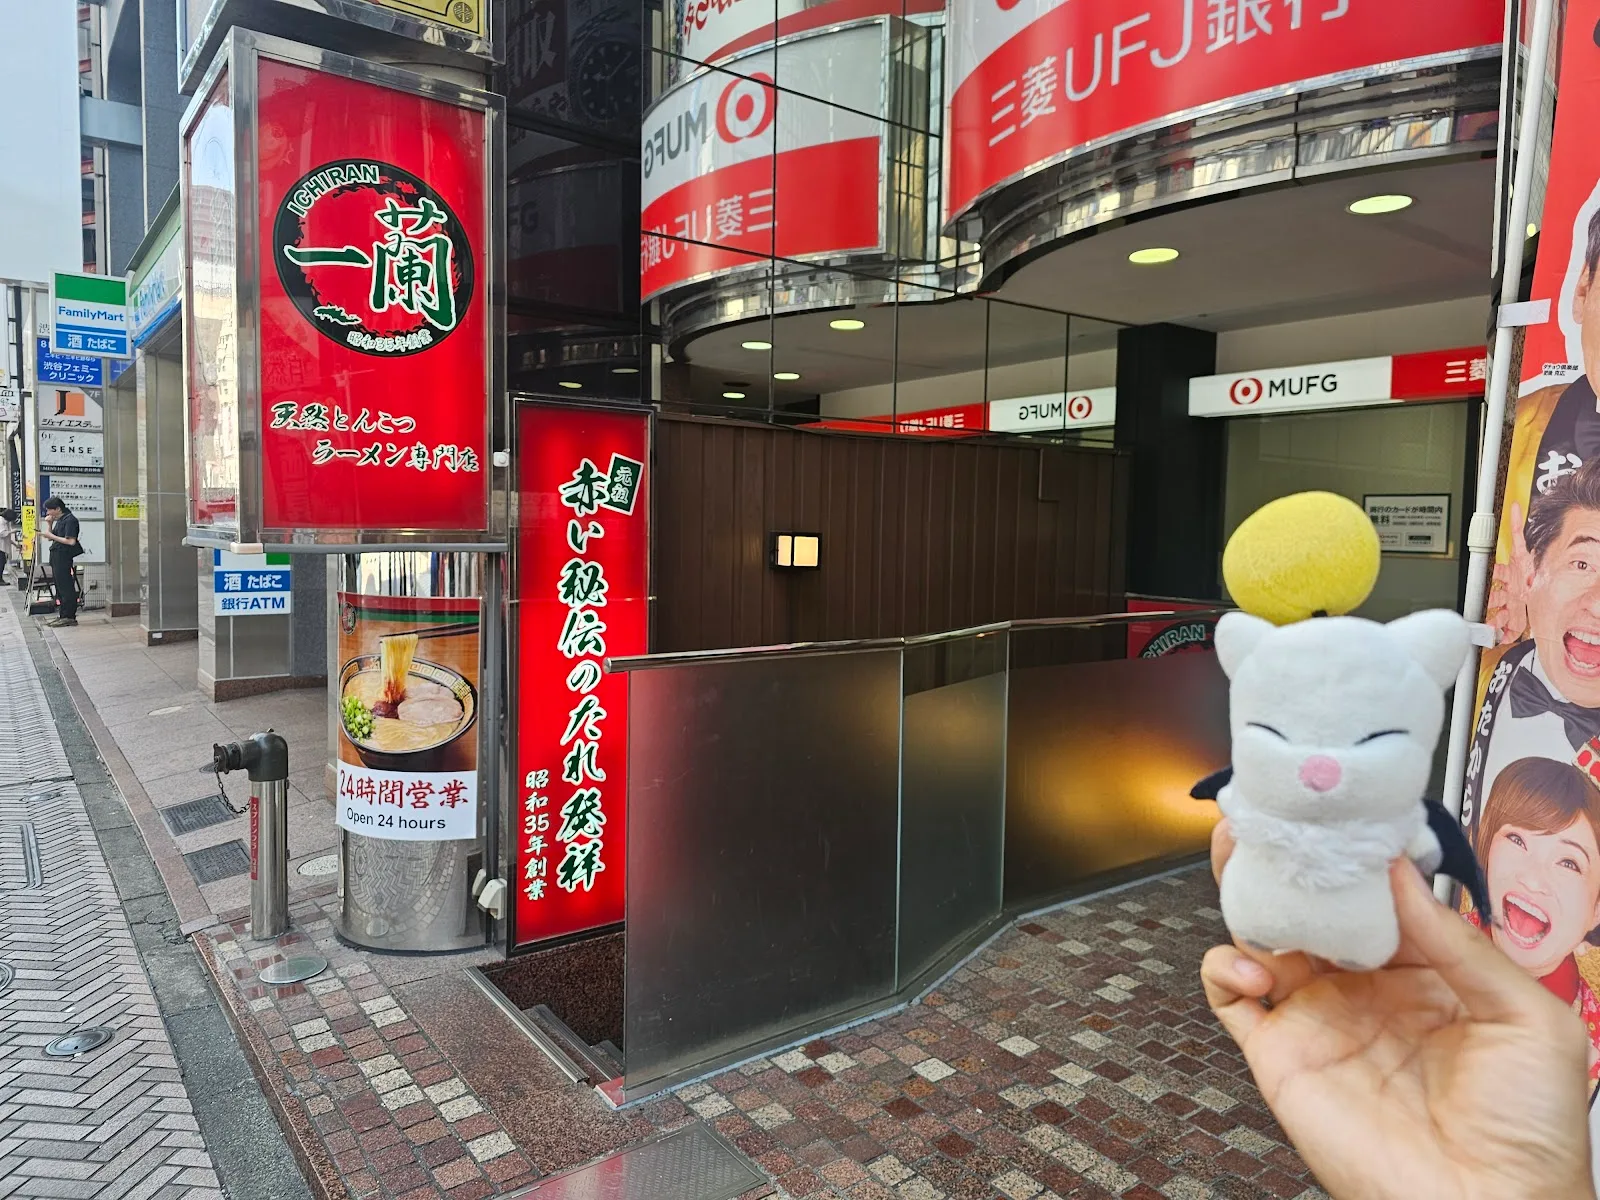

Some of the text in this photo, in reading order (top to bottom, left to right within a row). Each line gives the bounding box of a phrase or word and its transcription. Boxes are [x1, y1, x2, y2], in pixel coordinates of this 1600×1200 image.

[287, 164, 380, 218] ICHIRAN
[284, 197, 456, 331] 一蘭
[58, 306, 124, 321] FamilyMart
[68, 333, 117, 350] 酒 たばこ
[43, 362, 99, 373] 渋谷フェミー
[49, 371, 94, 382] クリニック
[1269, 374, 1338, 398] MUFG
[270, 401, 416, 434] 天然とんこつ
[51, 446, 93, 454] SENSE
[312, 439, 480, 472] ラーメン専門店
[610, 466, 633, 504] 元祖
[1536, 450, 1583, 495] お
[224, 573, 283, 591] 酒 たばこ
[222, 597, 285, 610] 銀行ATM
[557, 457, 611, 893] 赤い秘伝のたれ発祥
[340, 769, 469, 809] 24時間営業
[347, 807, 446, 829] Open 24 hours
[523, 768, 550, 900] 昭和35年創業
